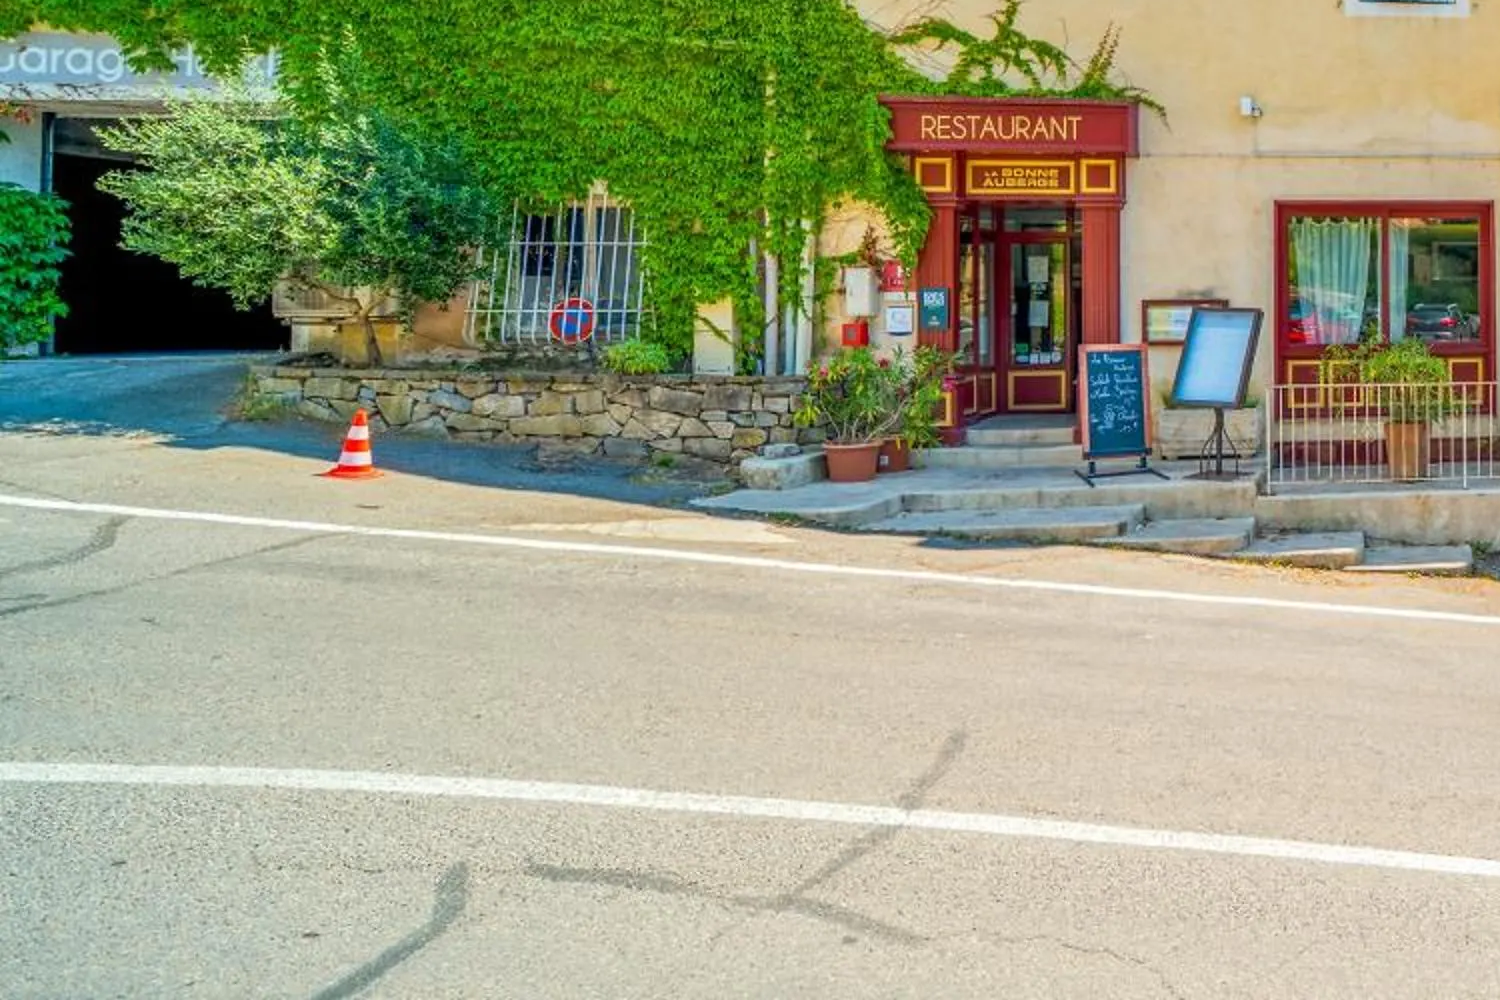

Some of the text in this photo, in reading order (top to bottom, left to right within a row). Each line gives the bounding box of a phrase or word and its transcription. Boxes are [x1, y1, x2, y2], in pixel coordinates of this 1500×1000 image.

[0, 45, 132, 83] arag
[920, 114, 1082, 141] RESTAURANT
[1001, 167, 1060, 178] BONNE
[982, 177, 1060, 188] AUBERGE
